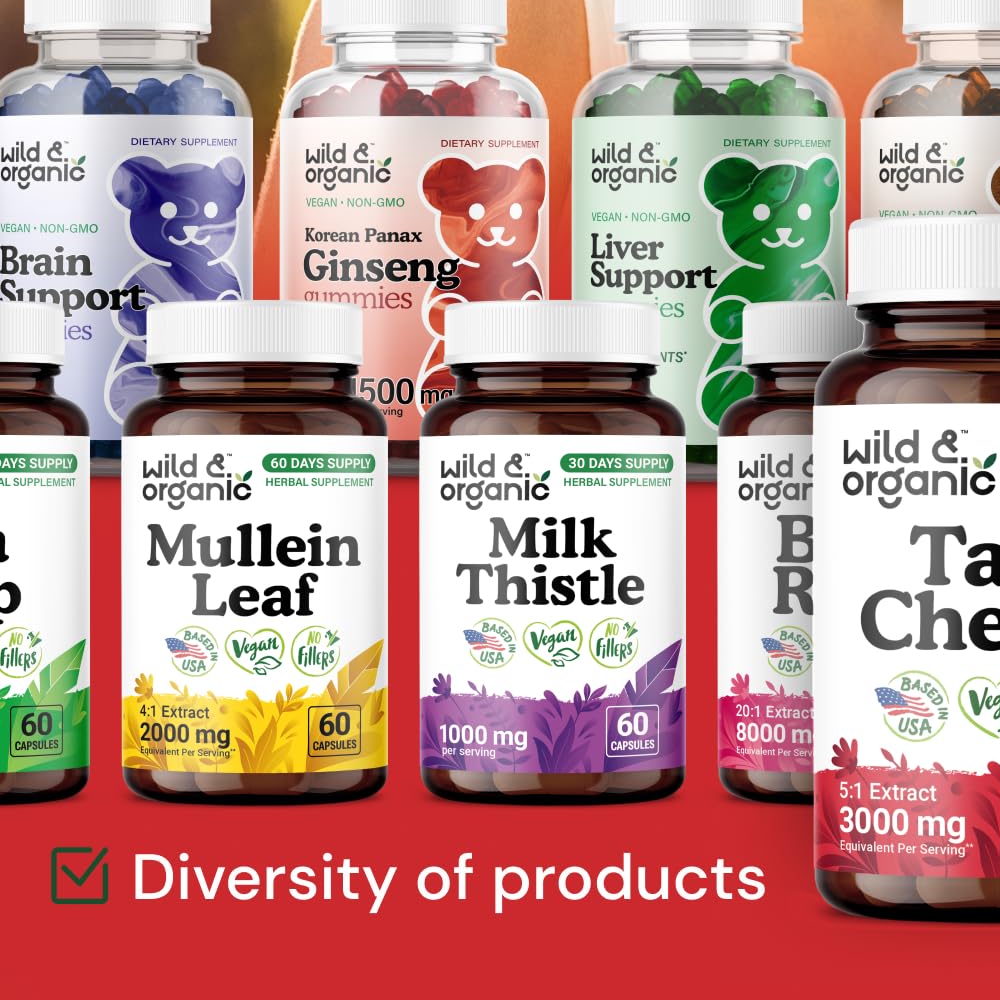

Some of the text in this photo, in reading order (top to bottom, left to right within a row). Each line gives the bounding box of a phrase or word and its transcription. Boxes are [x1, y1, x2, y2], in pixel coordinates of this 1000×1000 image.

[1, 141, 41, 162] wild
[131, 138, 237, 146] DIETARY SUPPLEMENT
[441, 139, 539, 148] DIETARY SUPPLEMENT
[723, 139, 831, 147] DIETARY SUPPLEMENT
[1, 159, 86, 189] organic
[306, 198, 404, 207] VEGAN NON-GMO
[591, 212, 690, 222] VEGAN NON-GMO
[0, 223, 98, 233] VEGAN NON-GMO
[305, 228, 422, 242] Korean Panax
[591, 233, 664, 260] Liver
[0, 246, 92, 276] Brain
[304, 250, 459, 289] Ginseng
[591, 261, 717, 294] Support
[843, 429, 958, 464] wild &
[143, 453, 197, 478] wild
[271, 458, 371, 469] 60 DAYS SUPPLY
[441, 453, 495, 478] wild
[569, 458, 668, 469] 30 DAYS SUPPLY
[143, 474, 252, 510] organic
[266, 478, 374, 487] HERBAL SUPPLEMENT
[441, 474, 549, 510] organic
[564, 478, 672, 486] HERBAL SUPPLEMENT
[843, 458, 995, 509] organic
[147, 523, 361, 567] Mullein
[489, 517, 617, 558] Milk
[192, 573, 318, 617] Leaf
[456, 564, 644, 606] Thistle
[232, 639, 279, 661] Vegan
[531, 630, 577, 653] Vegan
[182, 660, 206, 672] USA
[140, 705, 209, 718] 4:1 Extract
[319, 712, 350, 736] 60
[617, 712, 648, 736] 60
[736, 722, 785, 743] 8000
[898, 719, 932, 736] USA
[140, 723, 230, 749] 2000 mg
[313, 739, 356, 750] CAPSULES
[440, 725, 527, 750] 1000 mg
[611, 739, 655, 751] CAPSULES
[140, 746, 179, 757] Equivalent
[182, 748, 195, 757] Per
[442, 747, 495, 758] per serving
[839, 782, 937, 801] 5:1 Extract
[839, 806, 966, 843] 3000 mg
[840, 840, 894, 853] Equivalent
[897, 842, 916, 854] Per
